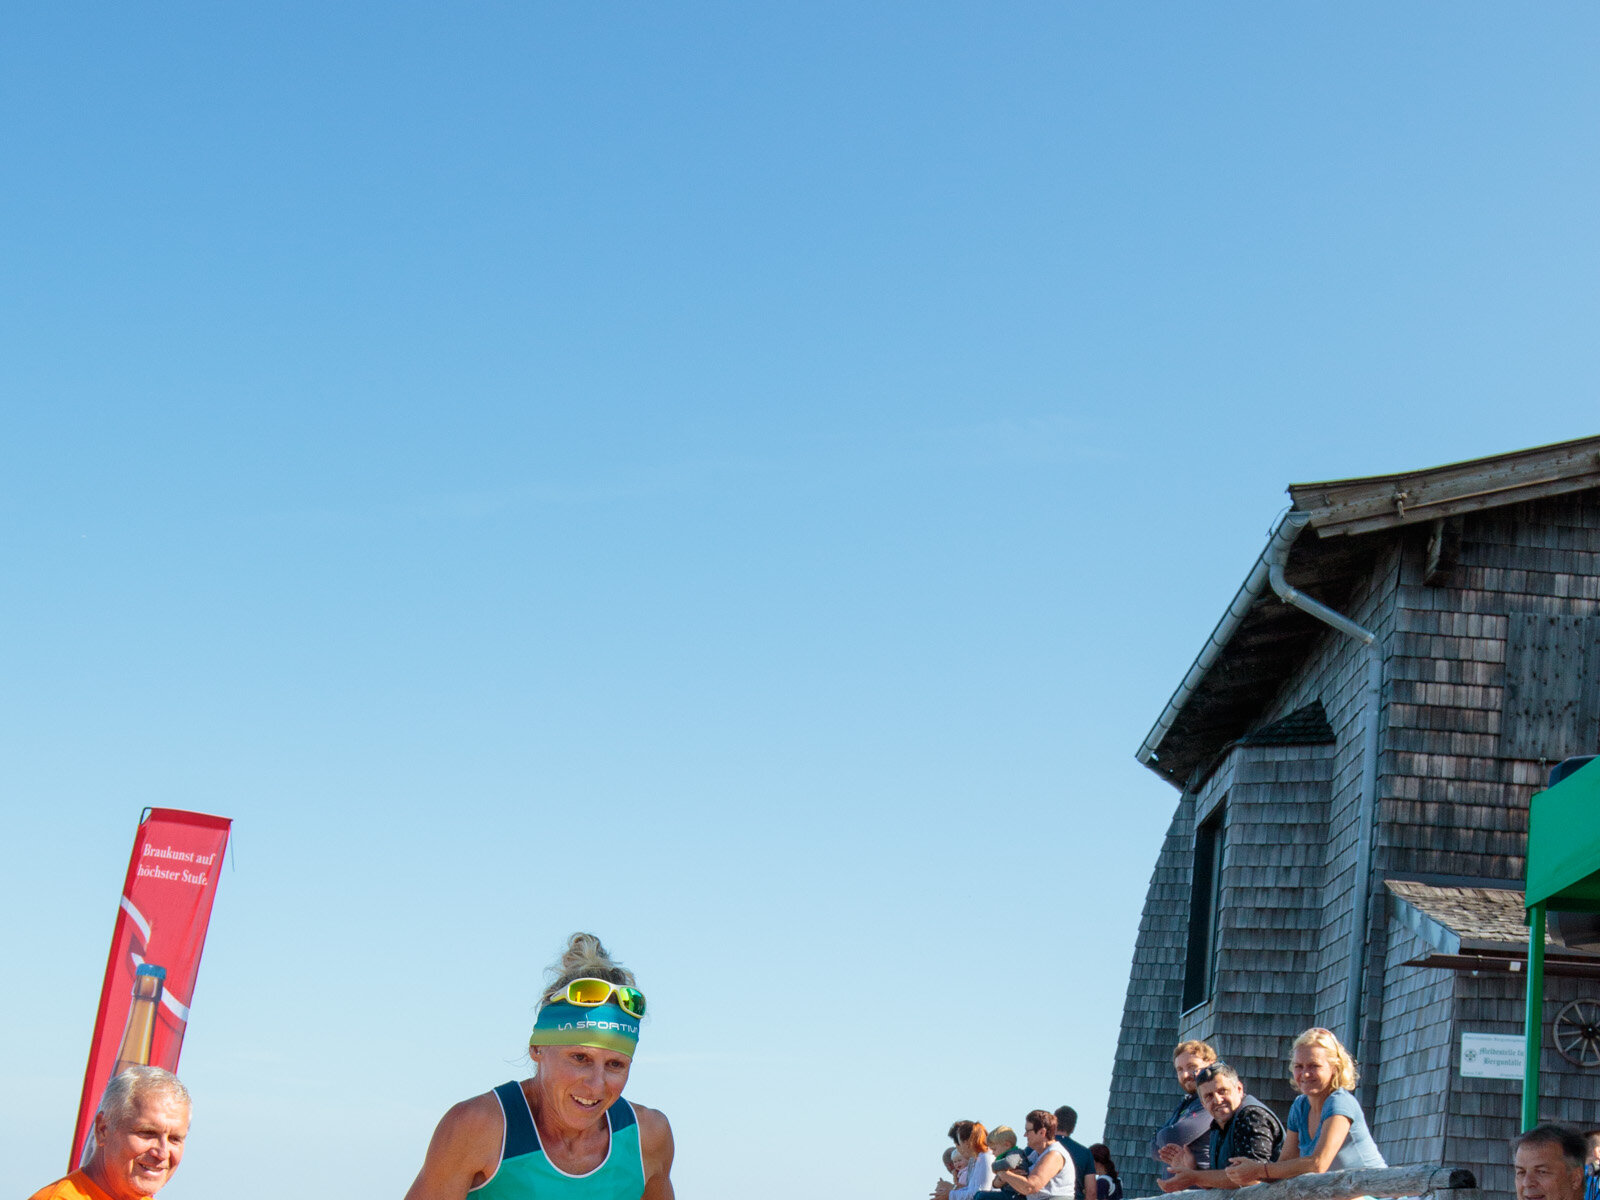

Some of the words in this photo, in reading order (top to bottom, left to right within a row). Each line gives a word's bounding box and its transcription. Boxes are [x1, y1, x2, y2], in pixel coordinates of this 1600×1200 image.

[143, 843, 194, 862] Braukunst
[195, 853, 216, 866] auf
[137, 864, 180, 880] höchster
[558, 1022, 572, 1031] LA
